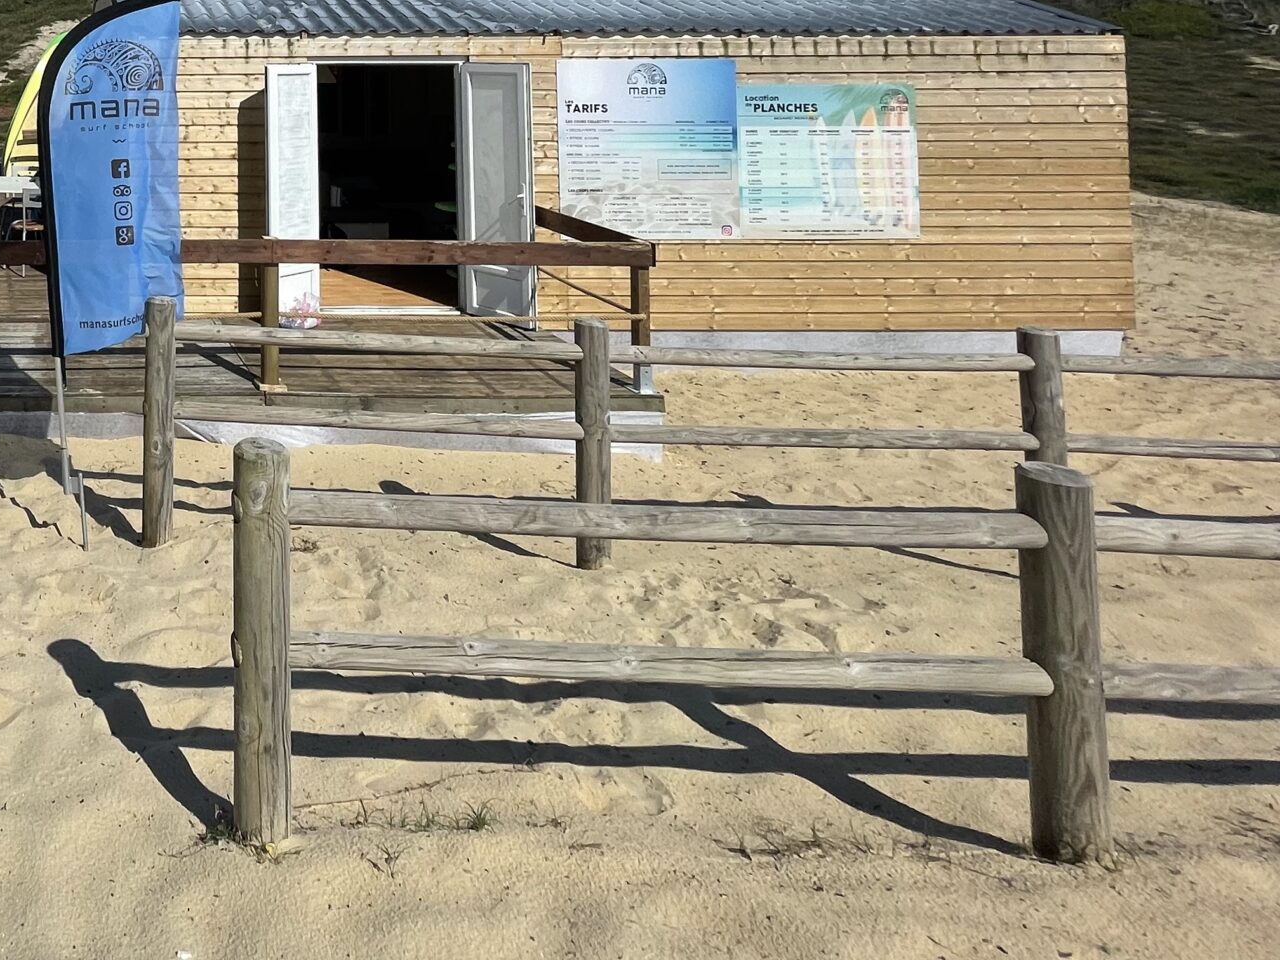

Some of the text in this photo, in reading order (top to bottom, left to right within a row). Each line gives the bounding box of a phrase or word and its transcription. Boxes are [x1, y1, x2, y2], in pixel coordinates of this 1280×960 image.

[628, 86, 666, 95] mana
[70, 98, 160, 120] mana
[566, 104, 608, 113] TARIFS
[753, 103, 818, 113] PLANCHES
[80, 122, 150, 132] surf school
[79, 313, 145, 329] manasurfscho
